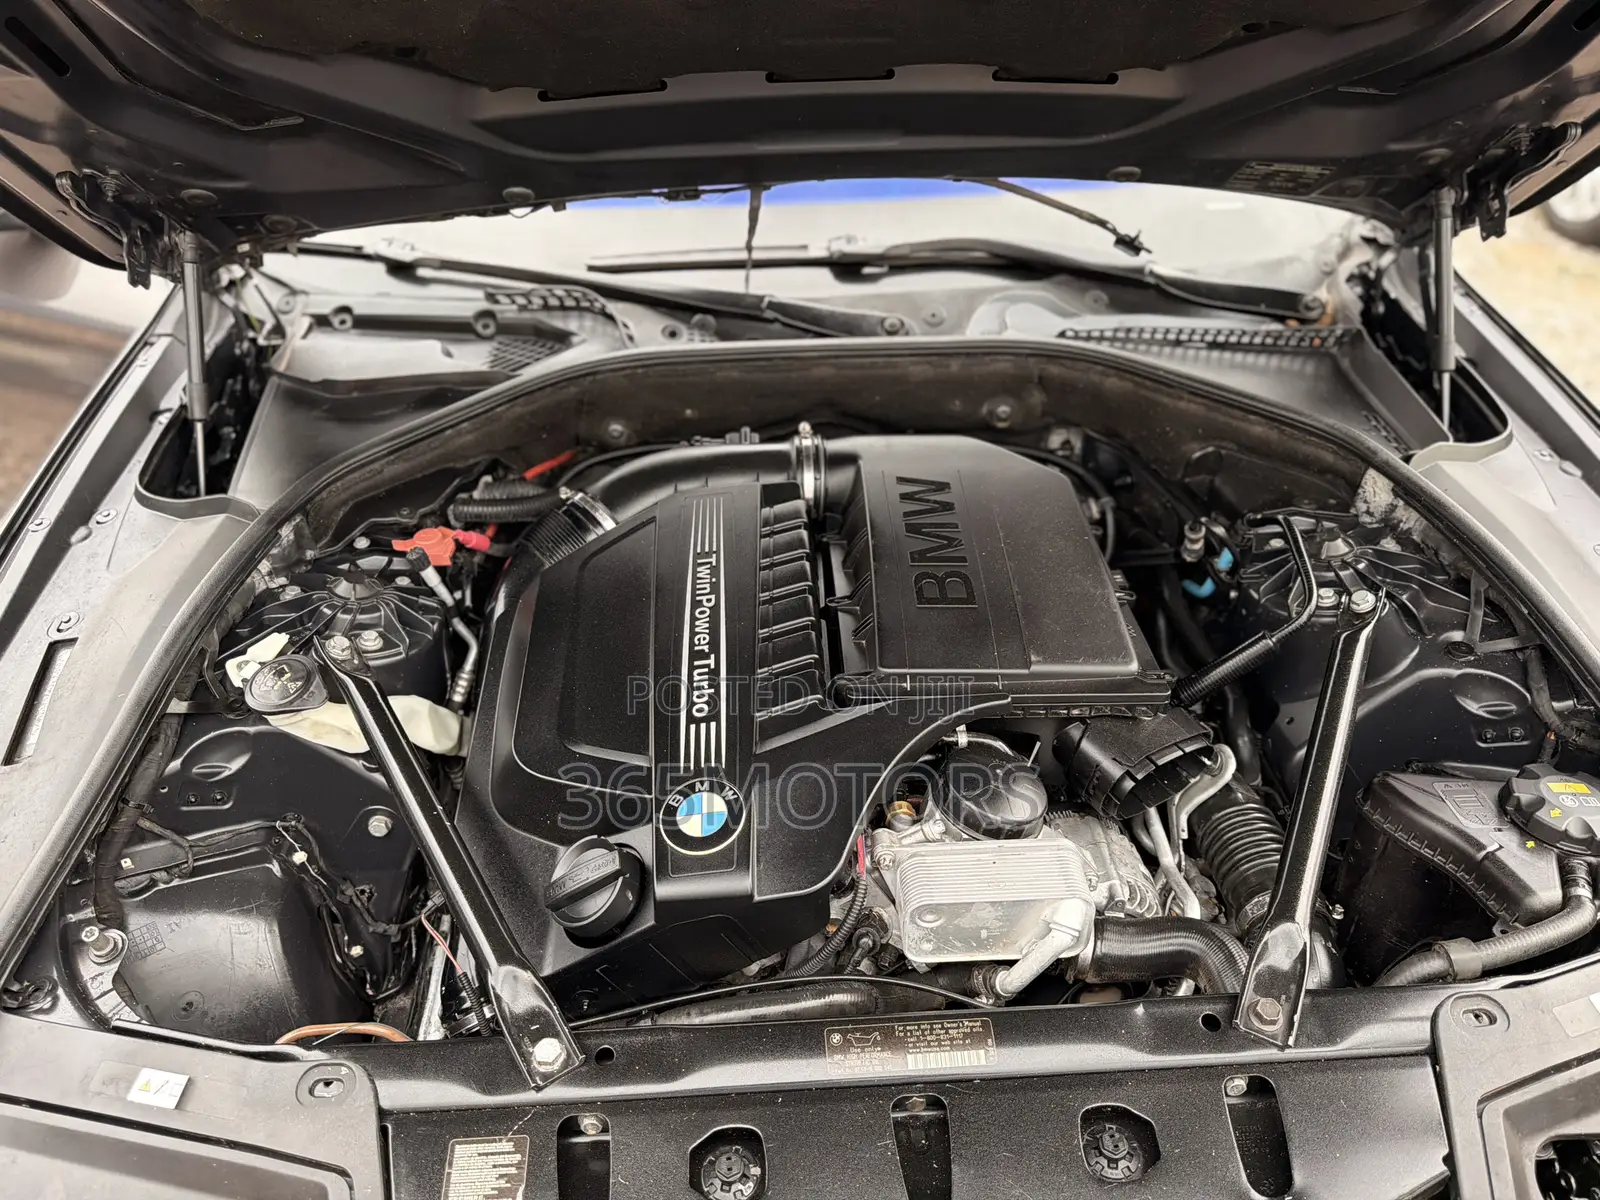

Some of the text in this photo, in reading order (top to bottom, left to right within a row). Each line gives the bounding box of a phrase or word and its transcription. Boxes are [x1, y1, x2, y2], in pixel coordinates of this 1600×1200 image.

[896, 476, 978, 608] BMW
[692, 553, 717, 718] TwinPower Turbo
[668, 781, 738, 808] BMW
[948, 1026, 971, 1035] approved
